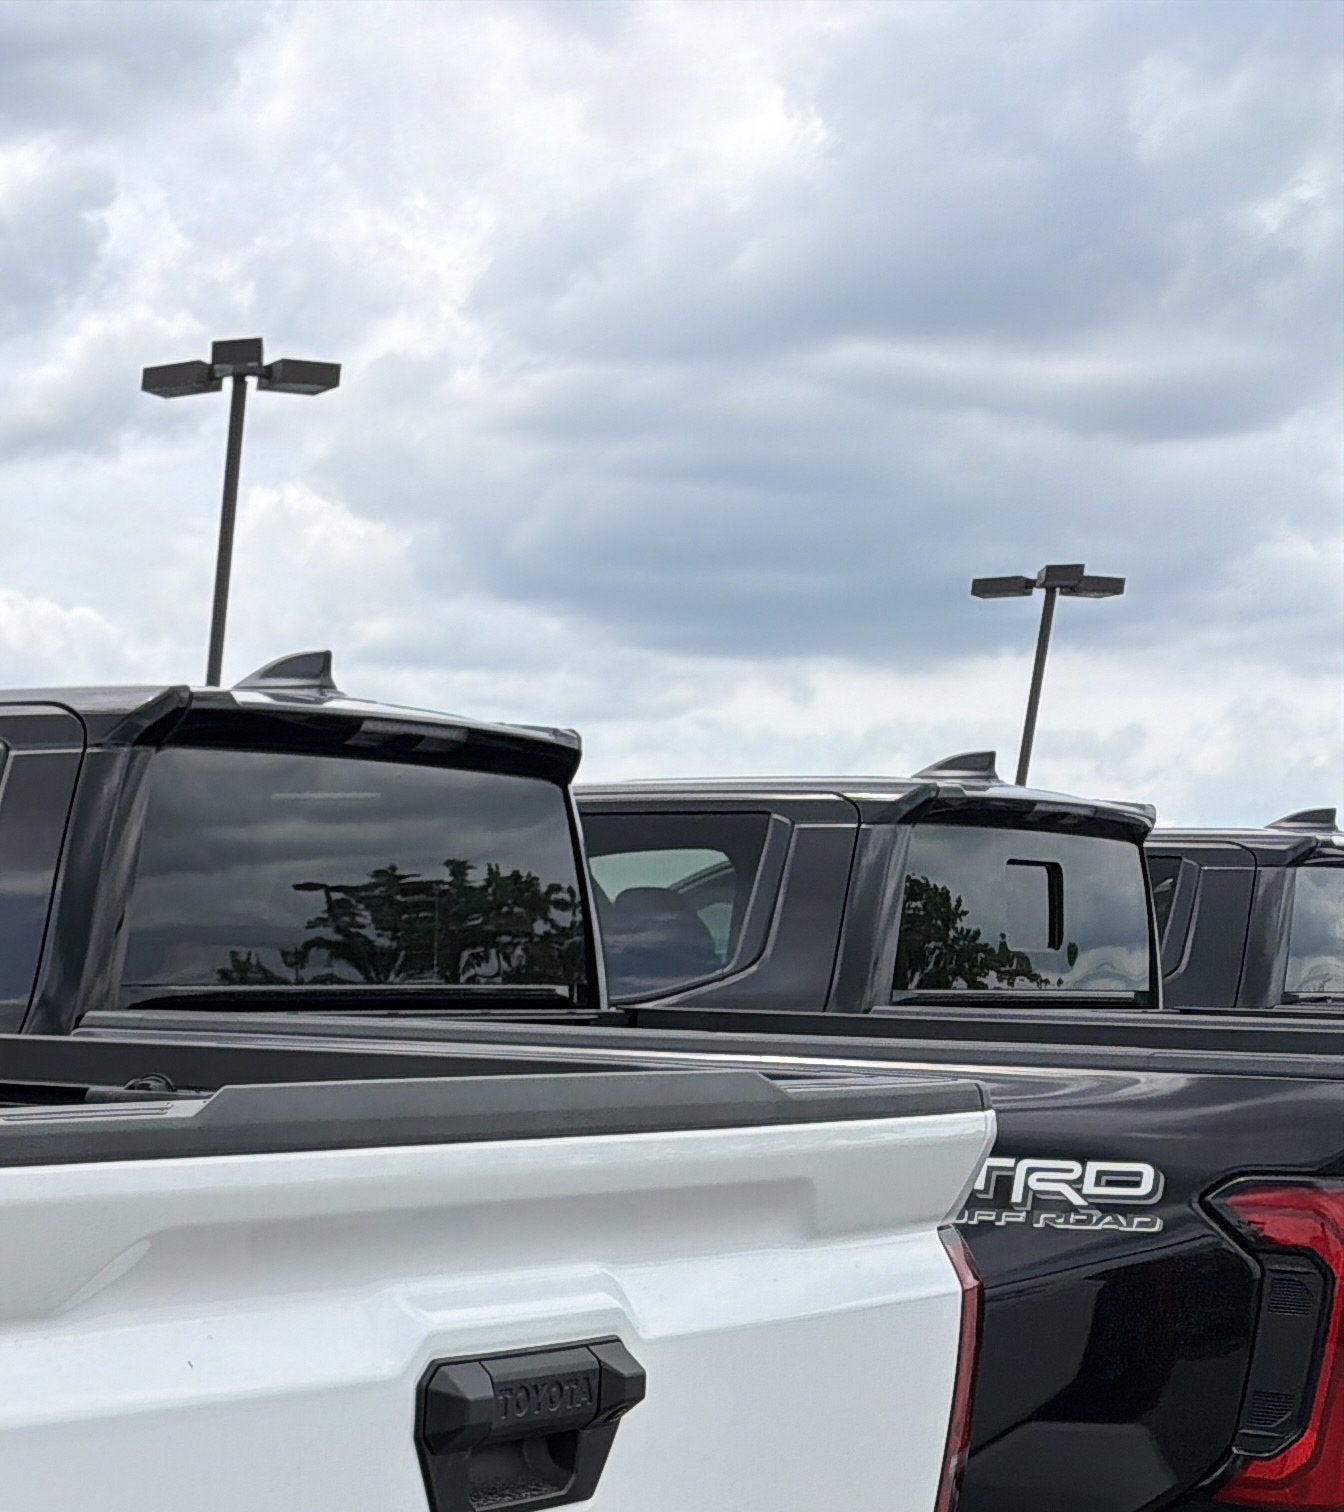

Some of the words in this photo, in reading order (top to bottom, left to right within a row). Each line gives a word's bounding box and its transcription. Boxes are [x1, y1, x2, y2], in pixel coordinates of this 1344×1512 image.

[973, 1157, 1165, 1211] TRD
[1033, 1210, 1163, 1232] ROAD
[496, 1376, 594, 1420] TOYOTA
